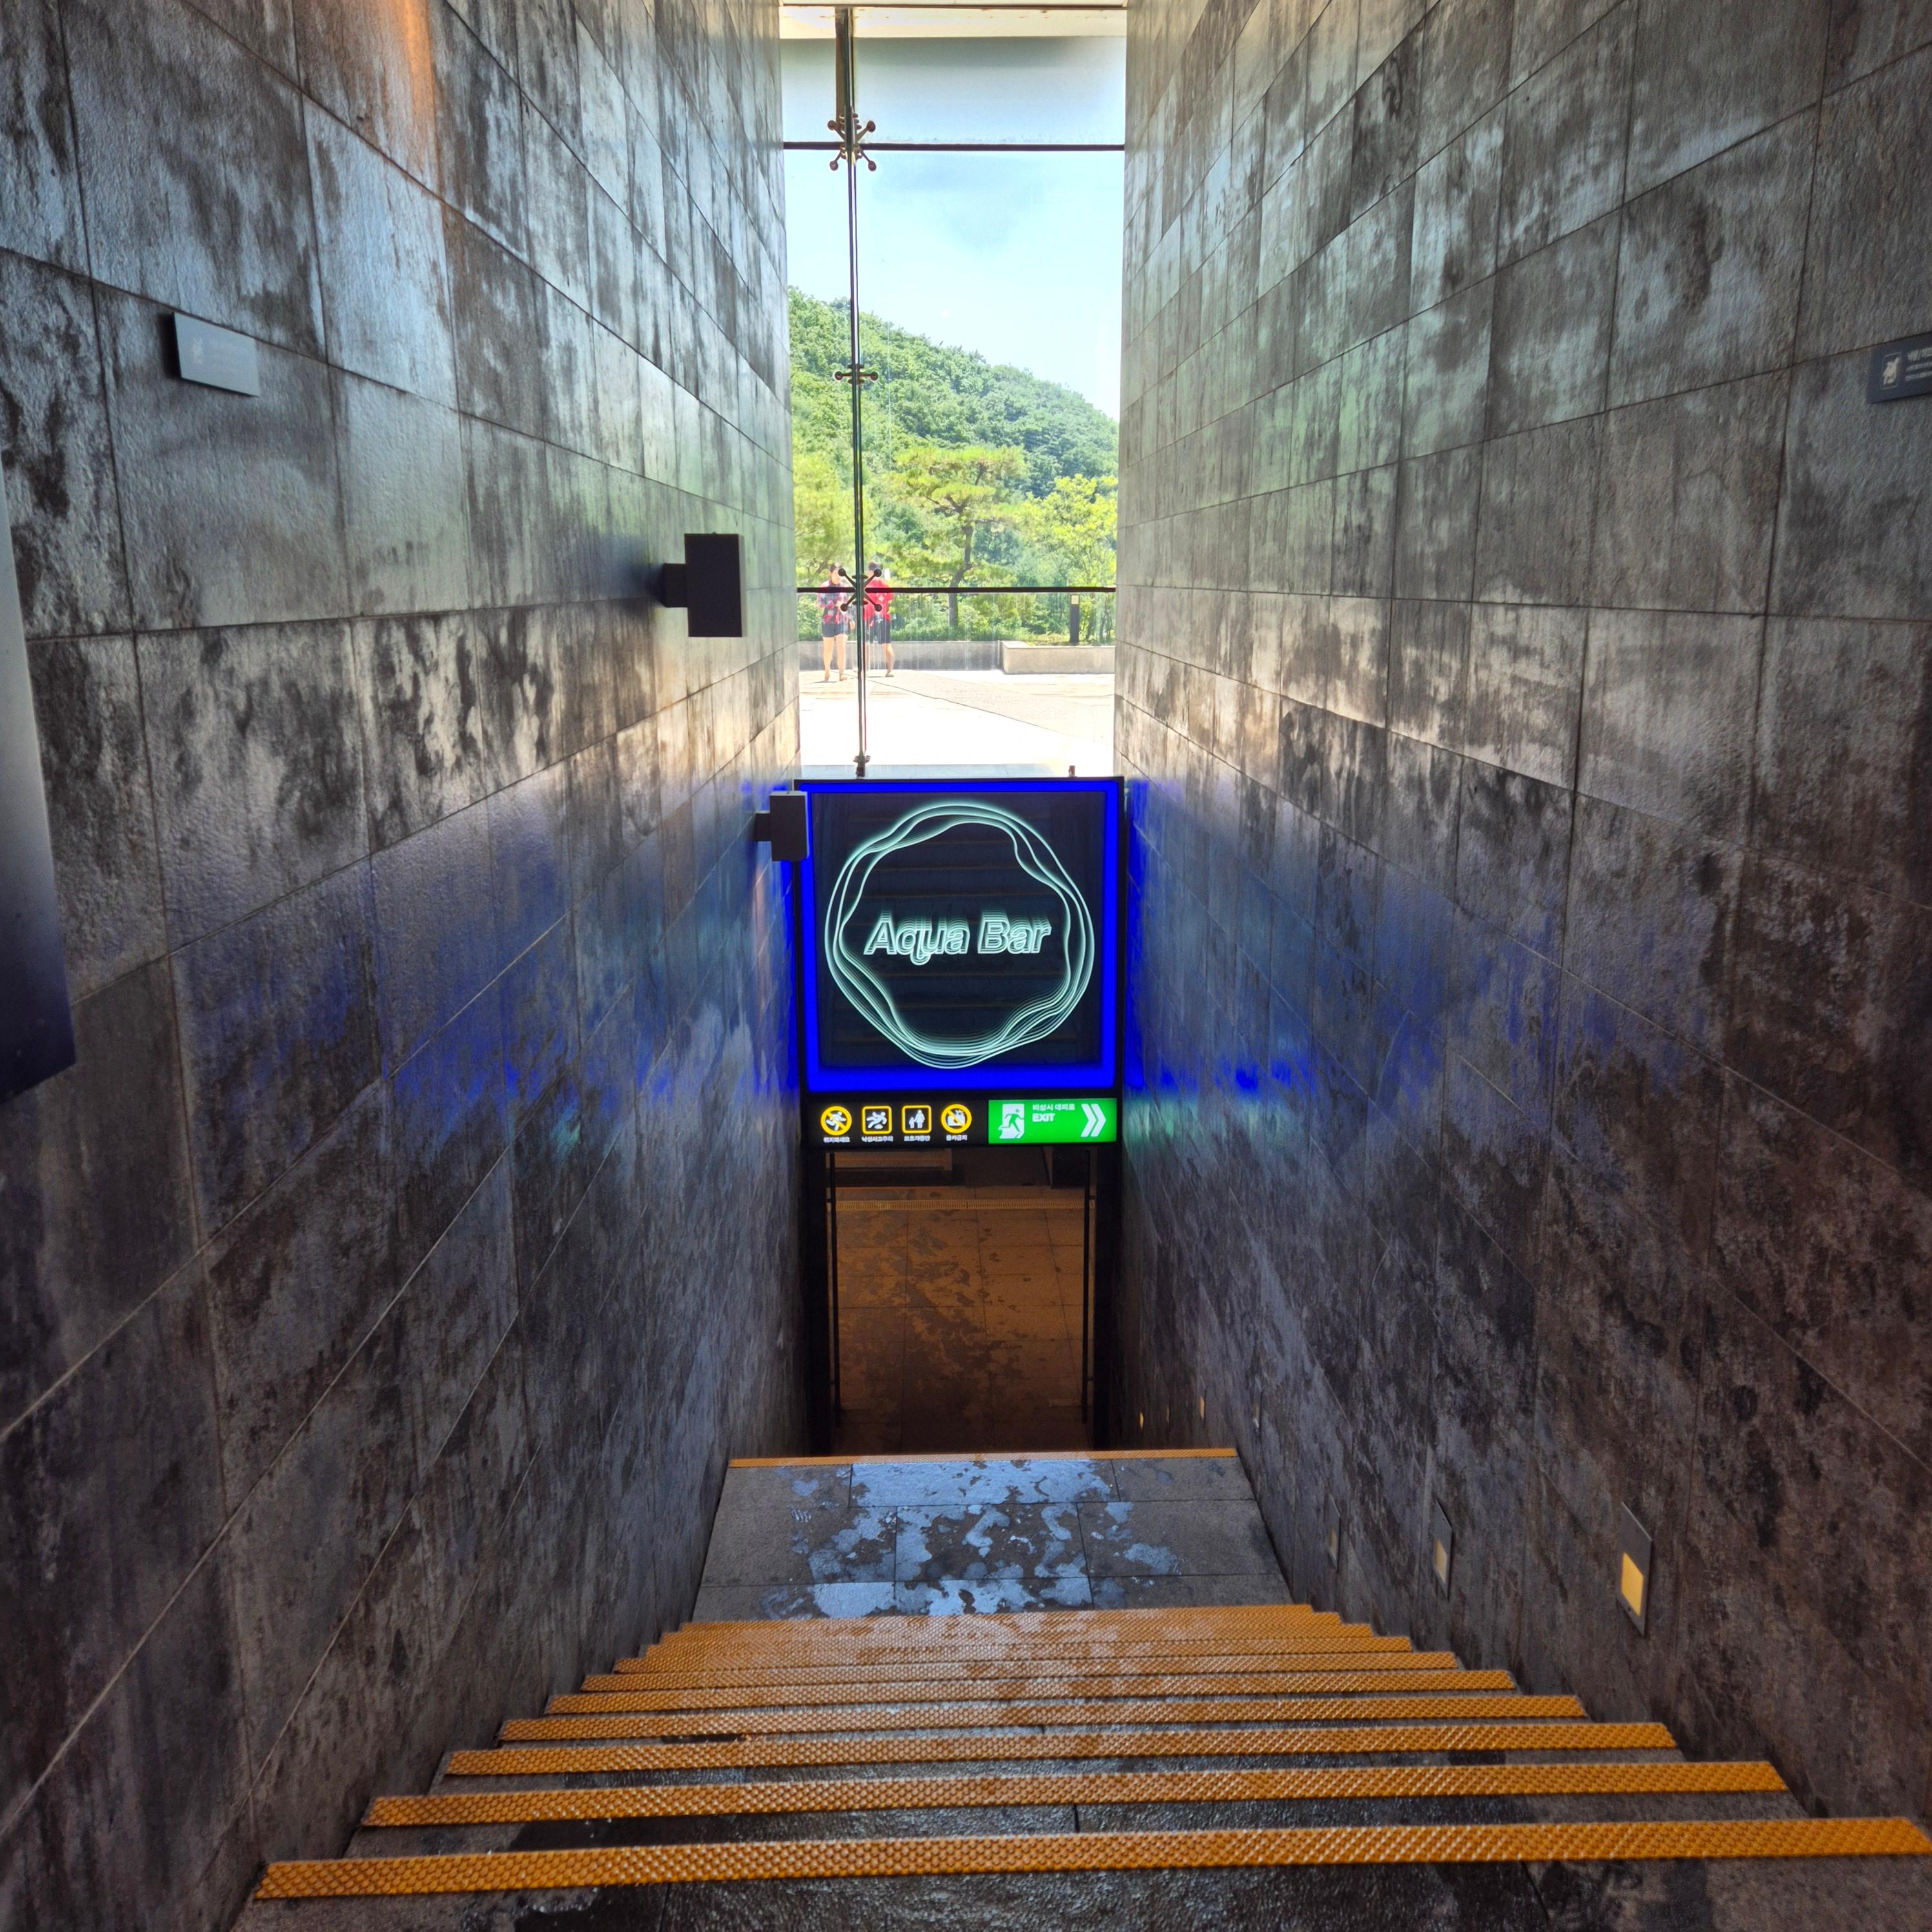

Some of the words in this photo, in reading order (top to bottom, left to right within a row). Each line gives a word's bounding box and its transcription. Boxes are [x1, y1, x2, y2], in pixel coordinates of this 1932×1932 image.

[863, 910, 971, 966] Aqua
[978, 912, 1052, 954] Bar
[1033, 1113, 1056, 1122] EXIT
